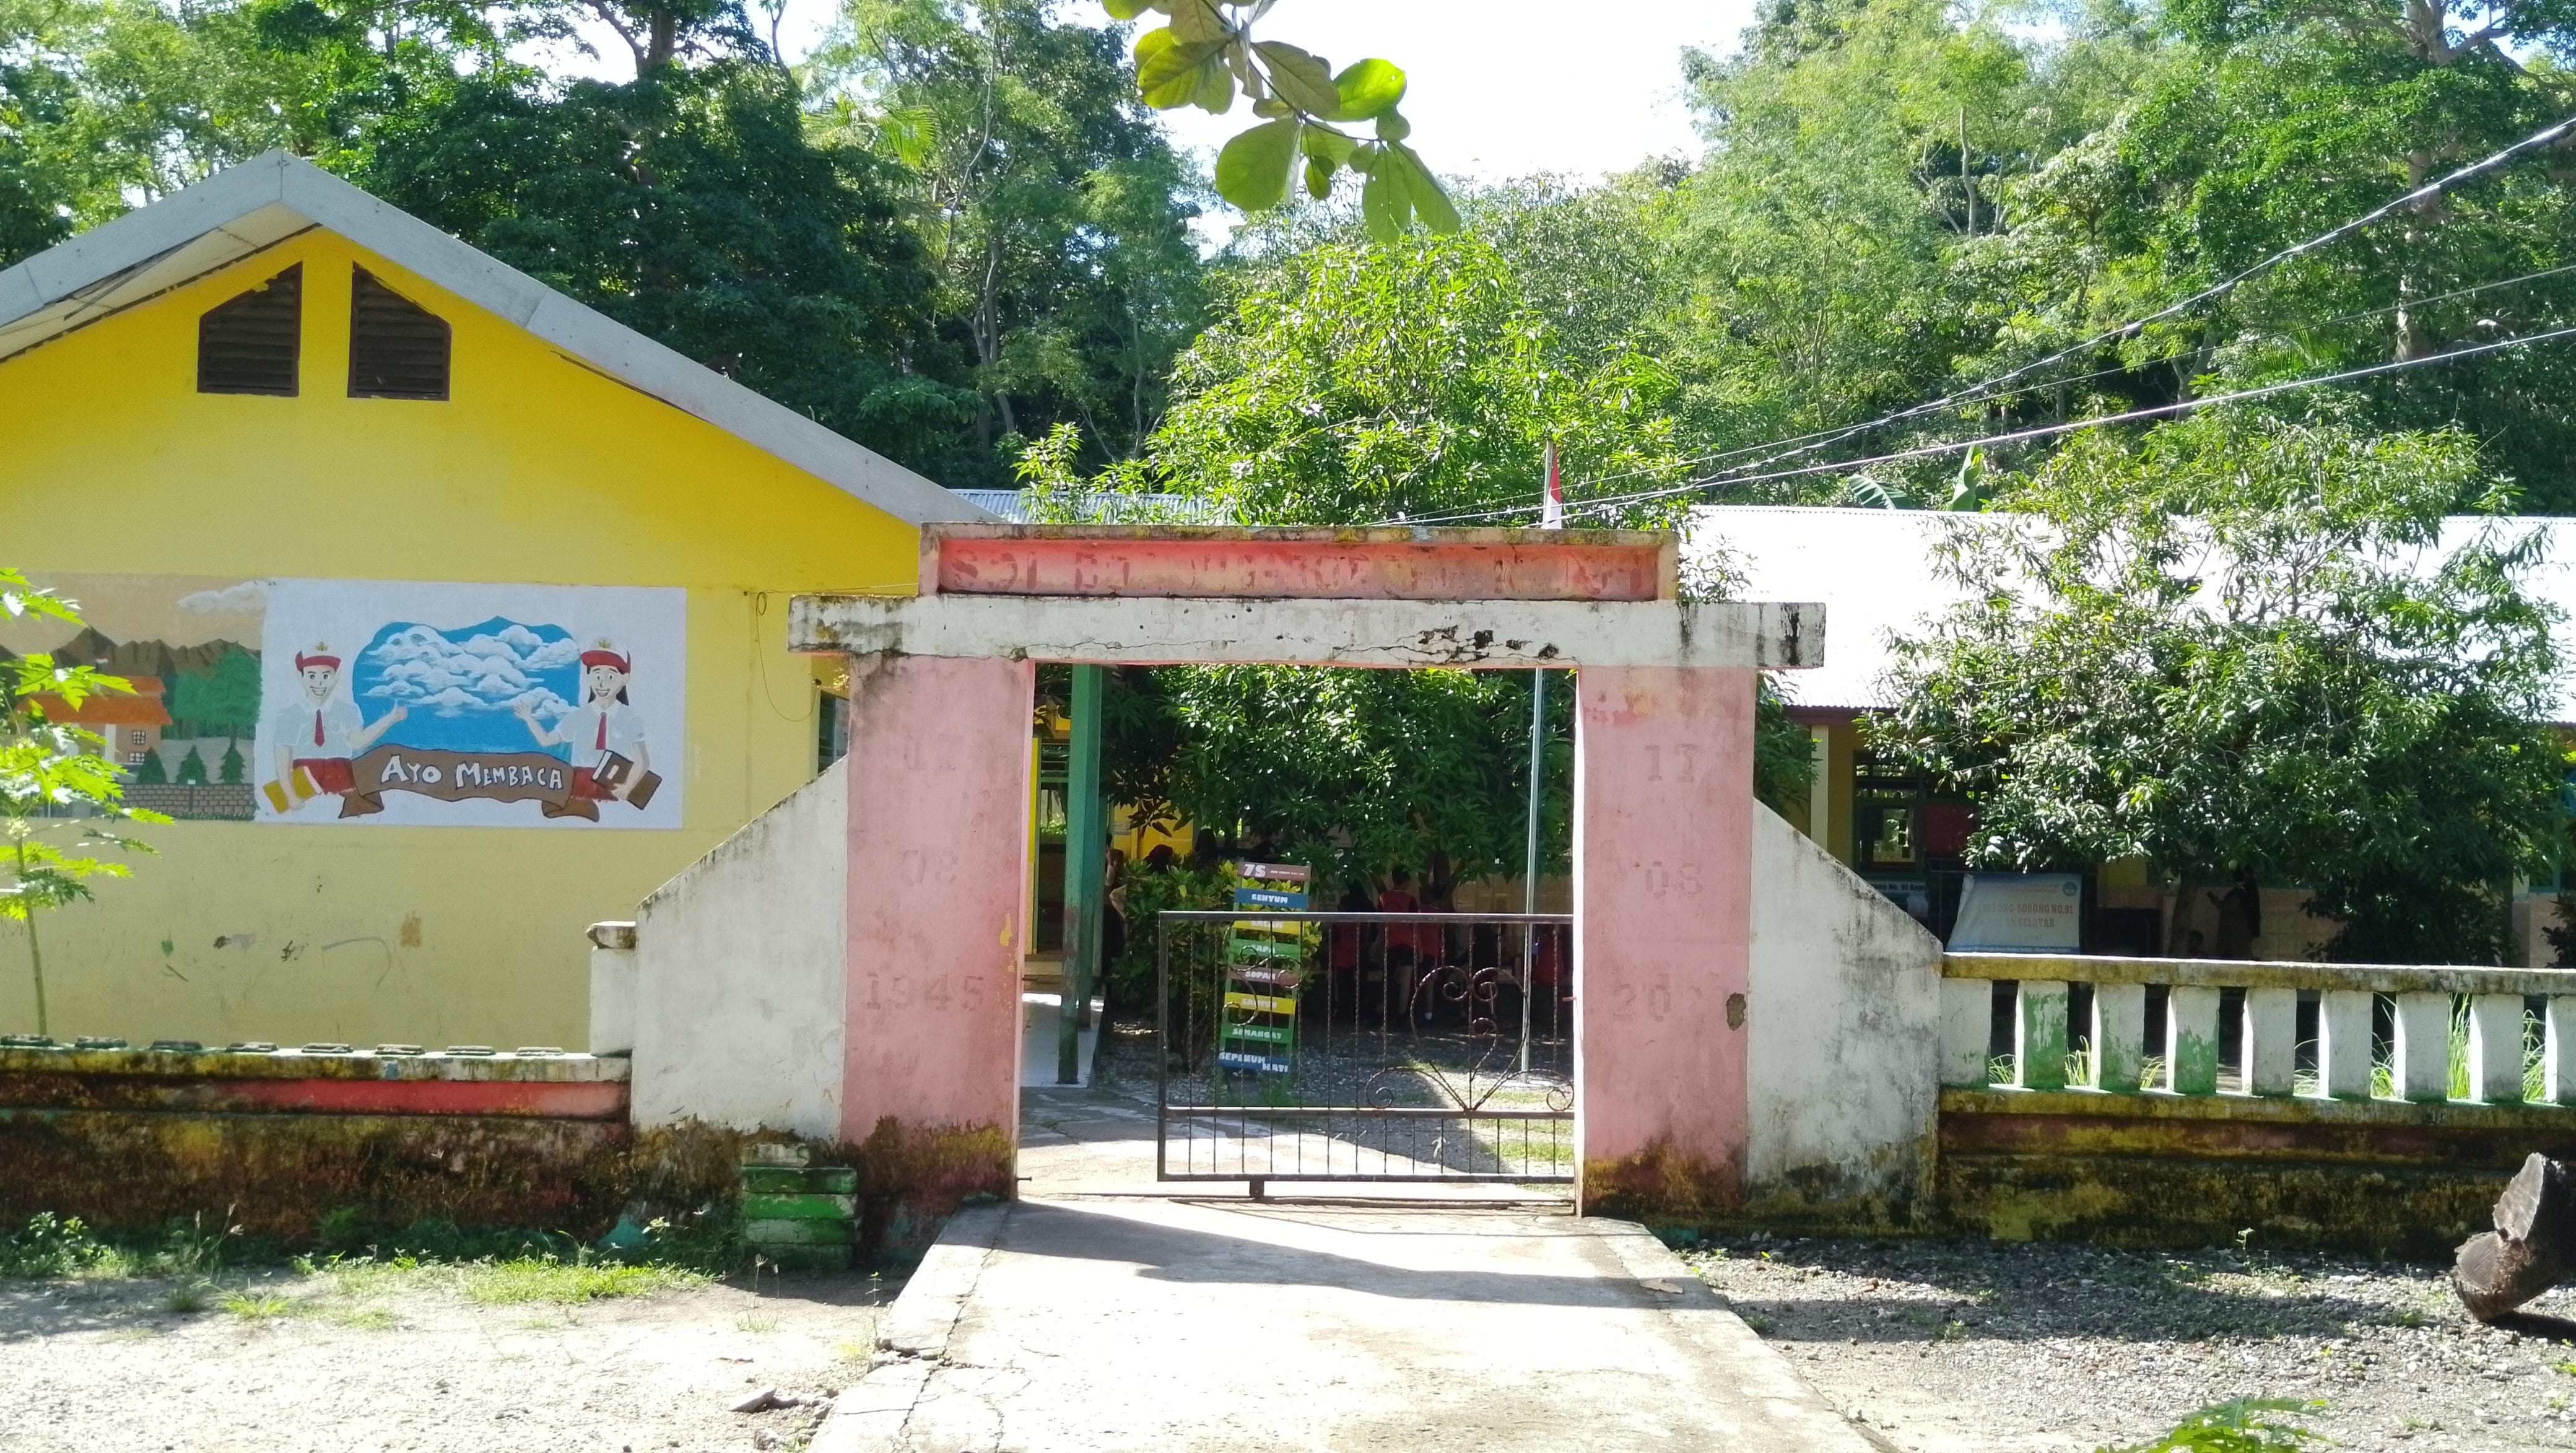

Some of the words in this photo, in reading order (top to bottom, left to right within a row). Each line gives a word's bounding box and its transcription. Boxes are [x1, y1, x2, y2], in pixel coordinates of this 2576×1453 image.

[381, 754, 442, 784] AYO
[455, 762, 563, 790] MEMBACA
[1244, 864, 1266, 877] 7S
[1251, 894, 1288, 904] SENYUM
[1262, 1063, 1288, 1073] HATI
